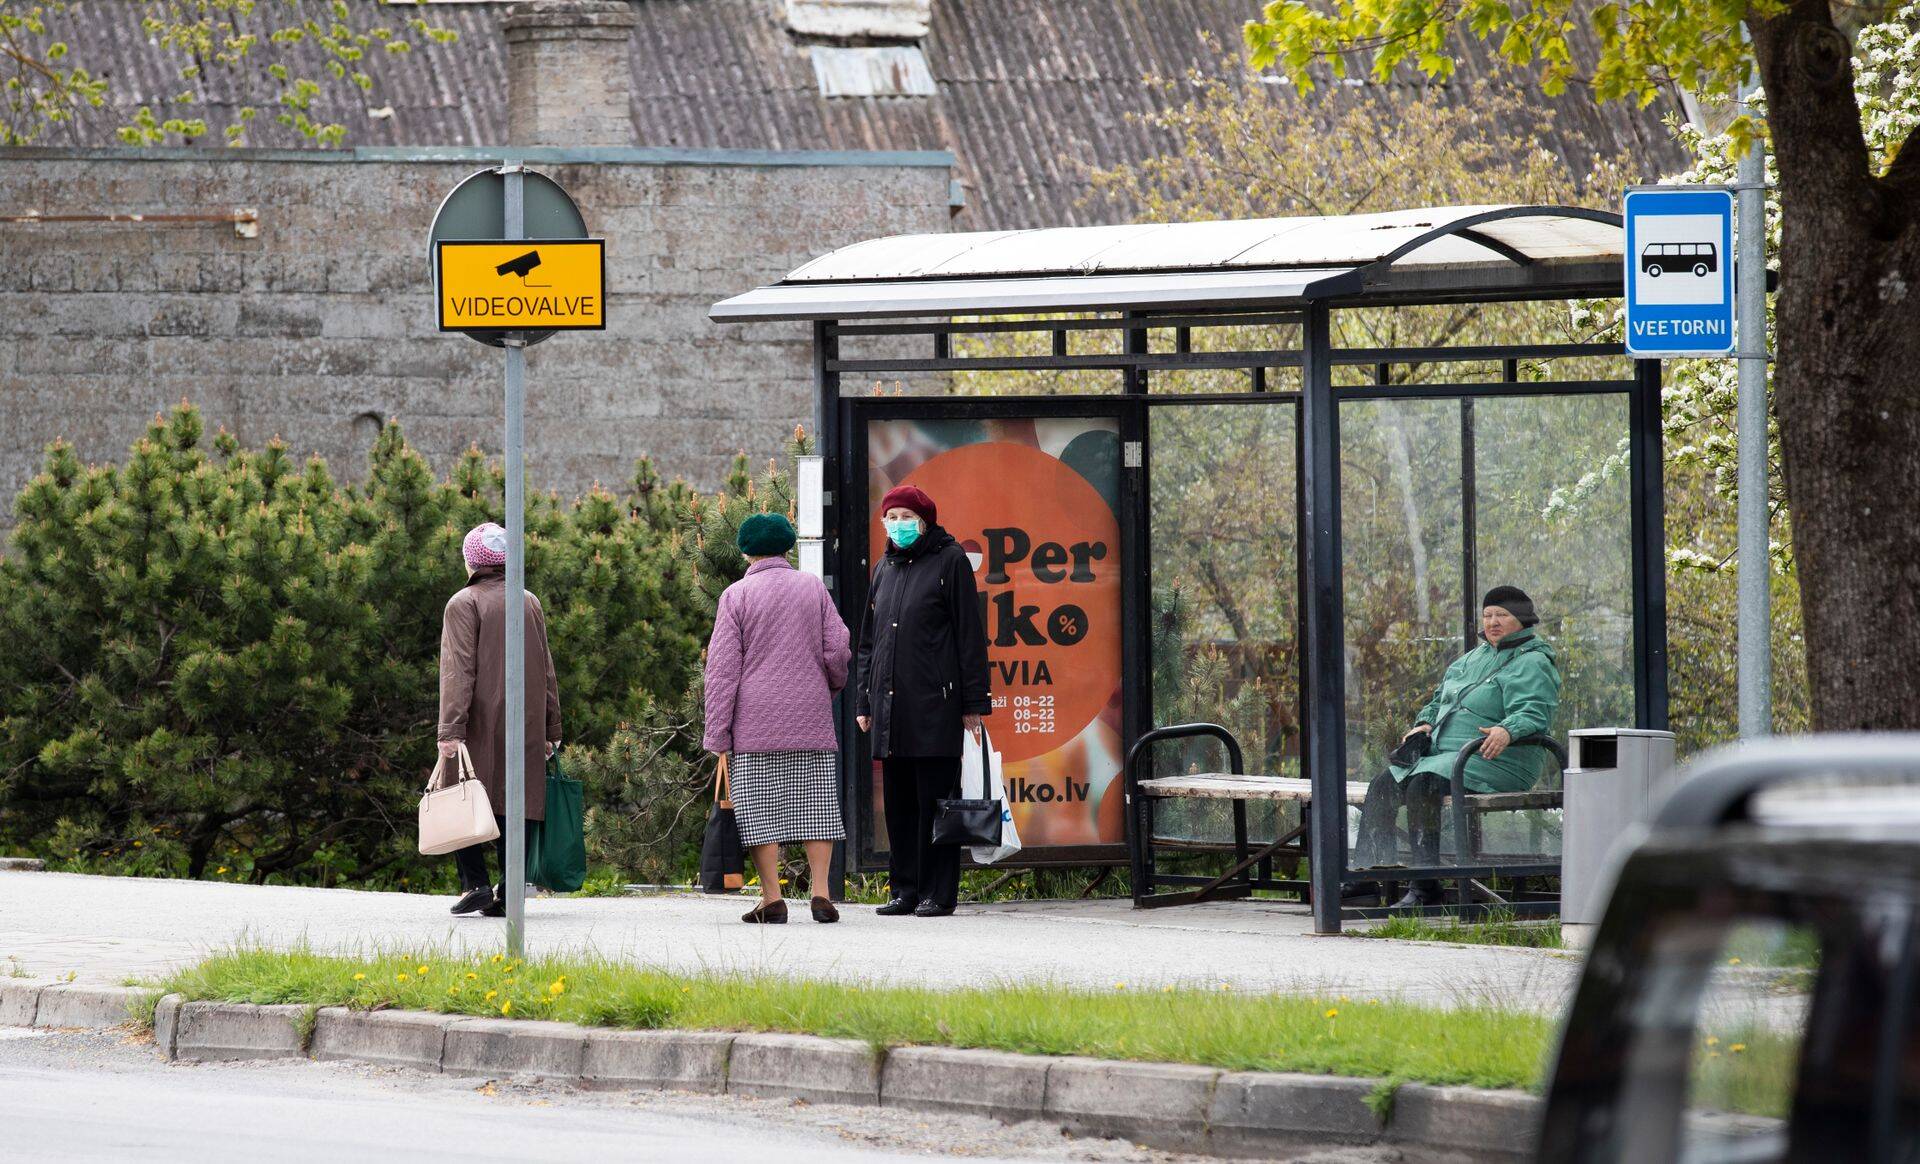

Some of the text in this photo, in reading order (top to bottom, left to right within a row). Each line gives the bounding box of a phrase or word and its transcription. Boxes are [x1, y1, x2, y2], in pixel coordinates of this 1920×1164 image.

[451, 296, 594, 317] VIDEOVALVE
[982, 527, 1107, 584] Per
[992, 695, 1055, 708] aži 08-22
[1013, 708, 1055, 720] 08-22
[1014, 722, 1055, 734] 10-22
